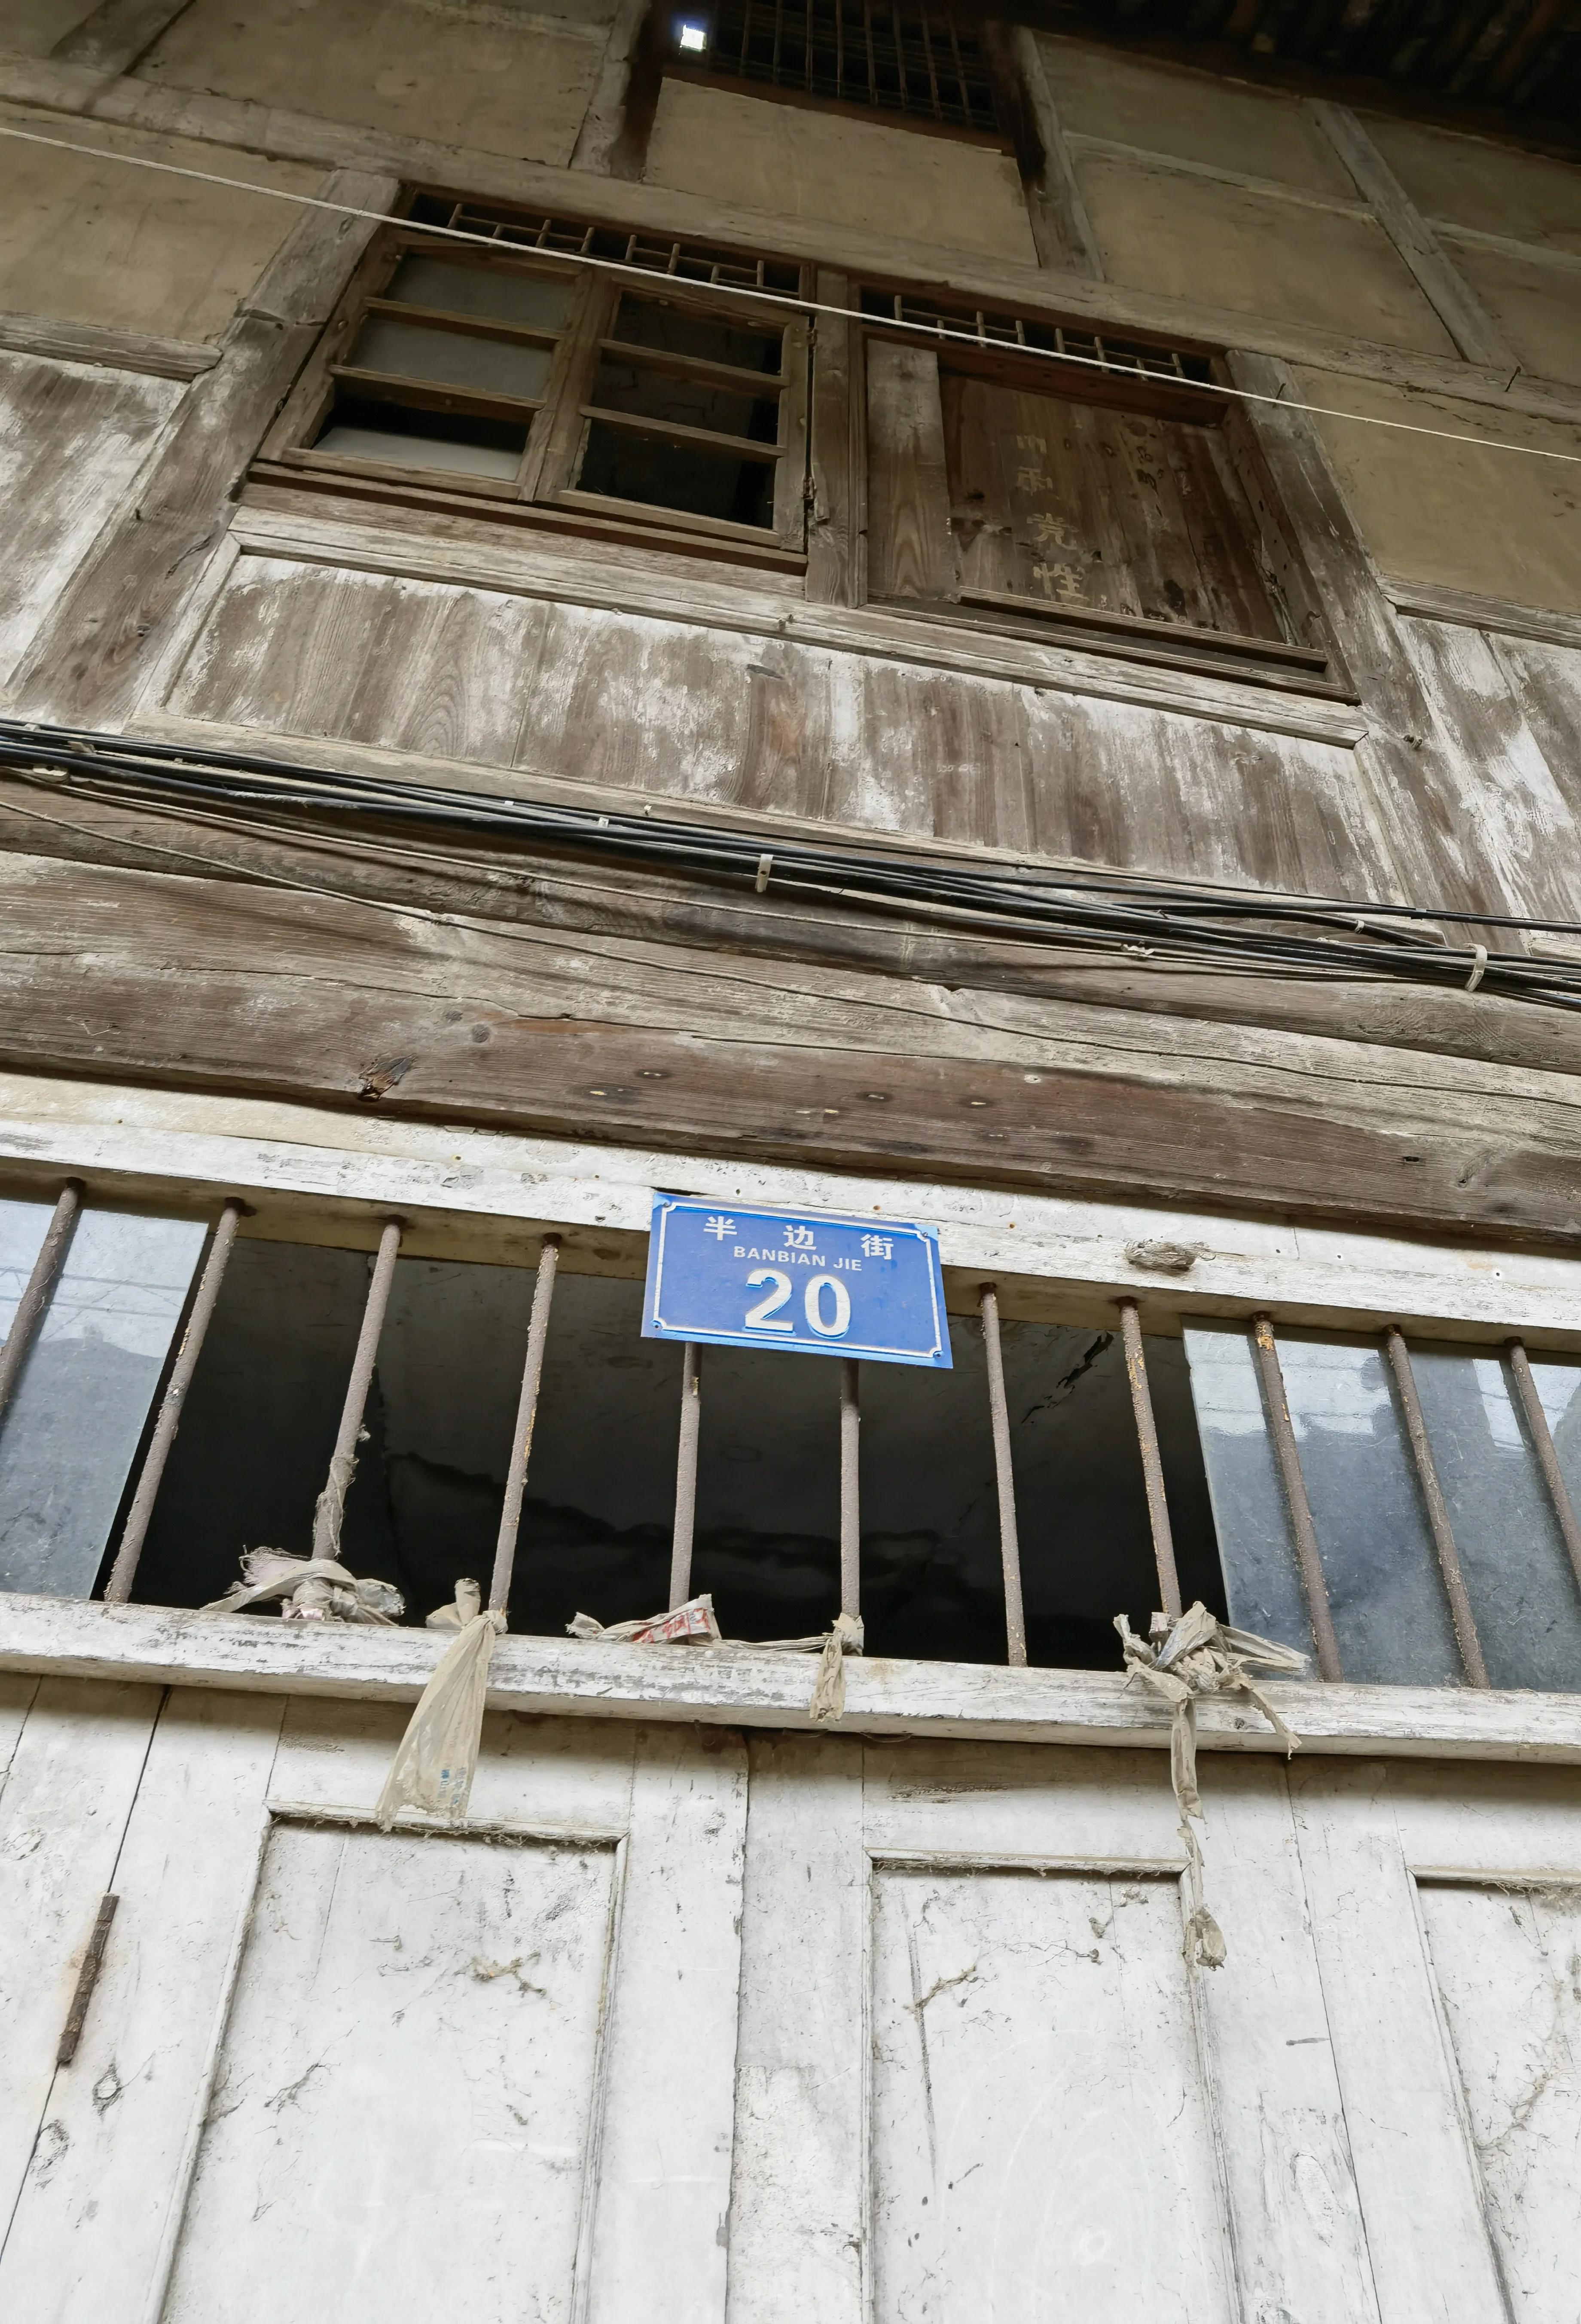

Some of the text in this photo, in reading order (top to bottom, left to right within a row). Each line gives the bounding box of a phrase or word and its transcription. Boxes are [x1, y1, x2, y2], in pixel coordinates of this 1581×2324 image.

[703, 1215, 894, 1260] 半边街
[734, 1246, 862, 1271] BANBIAN JIE
[744, 1268, 851, 1336] 20
